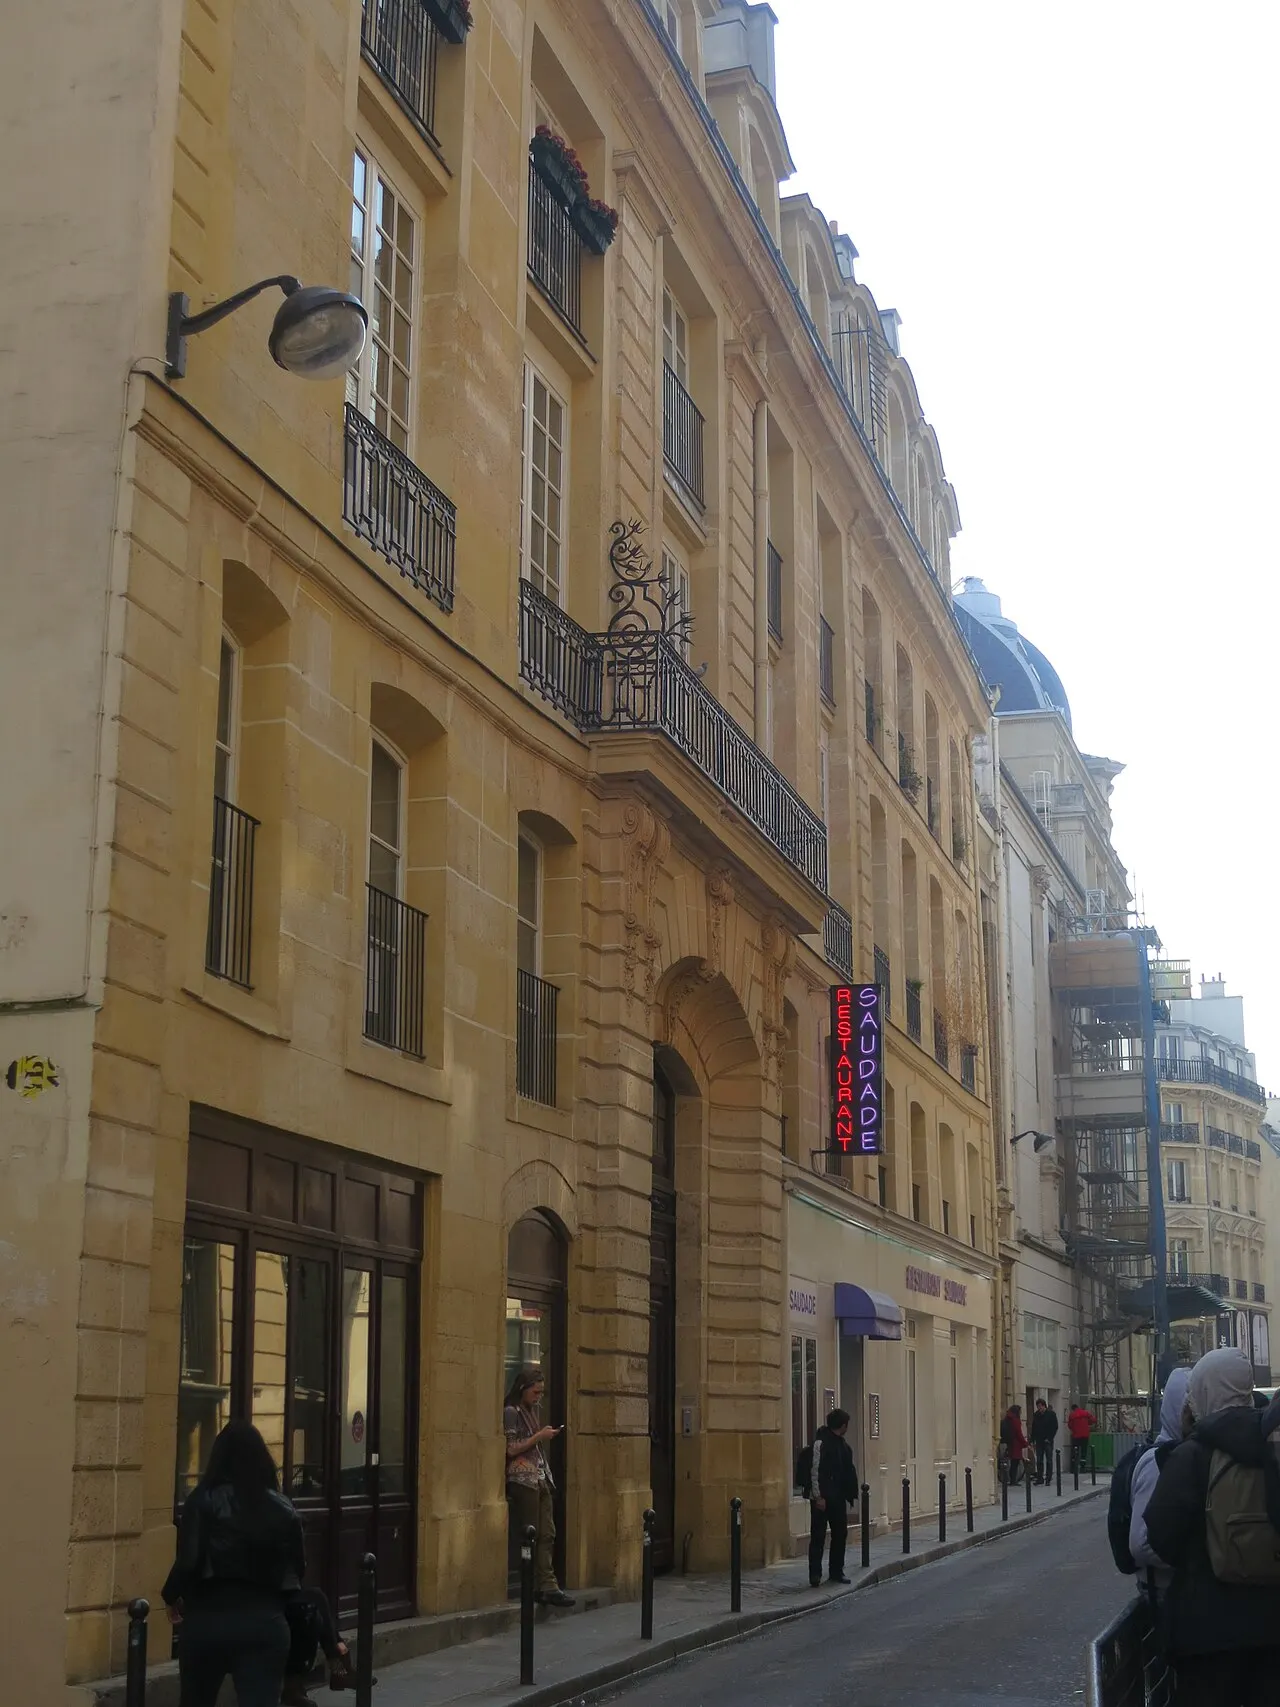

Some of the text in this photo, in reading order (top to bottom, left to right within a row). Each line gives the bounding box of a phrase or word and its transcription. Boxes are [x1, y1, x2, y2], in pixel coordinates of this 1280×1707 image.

[836, 988, 852, 1152] RESTAURANT
[859, 987, 878, 1150] SAUDADE
[789, 1288, 816, 1316] SAUDADE
